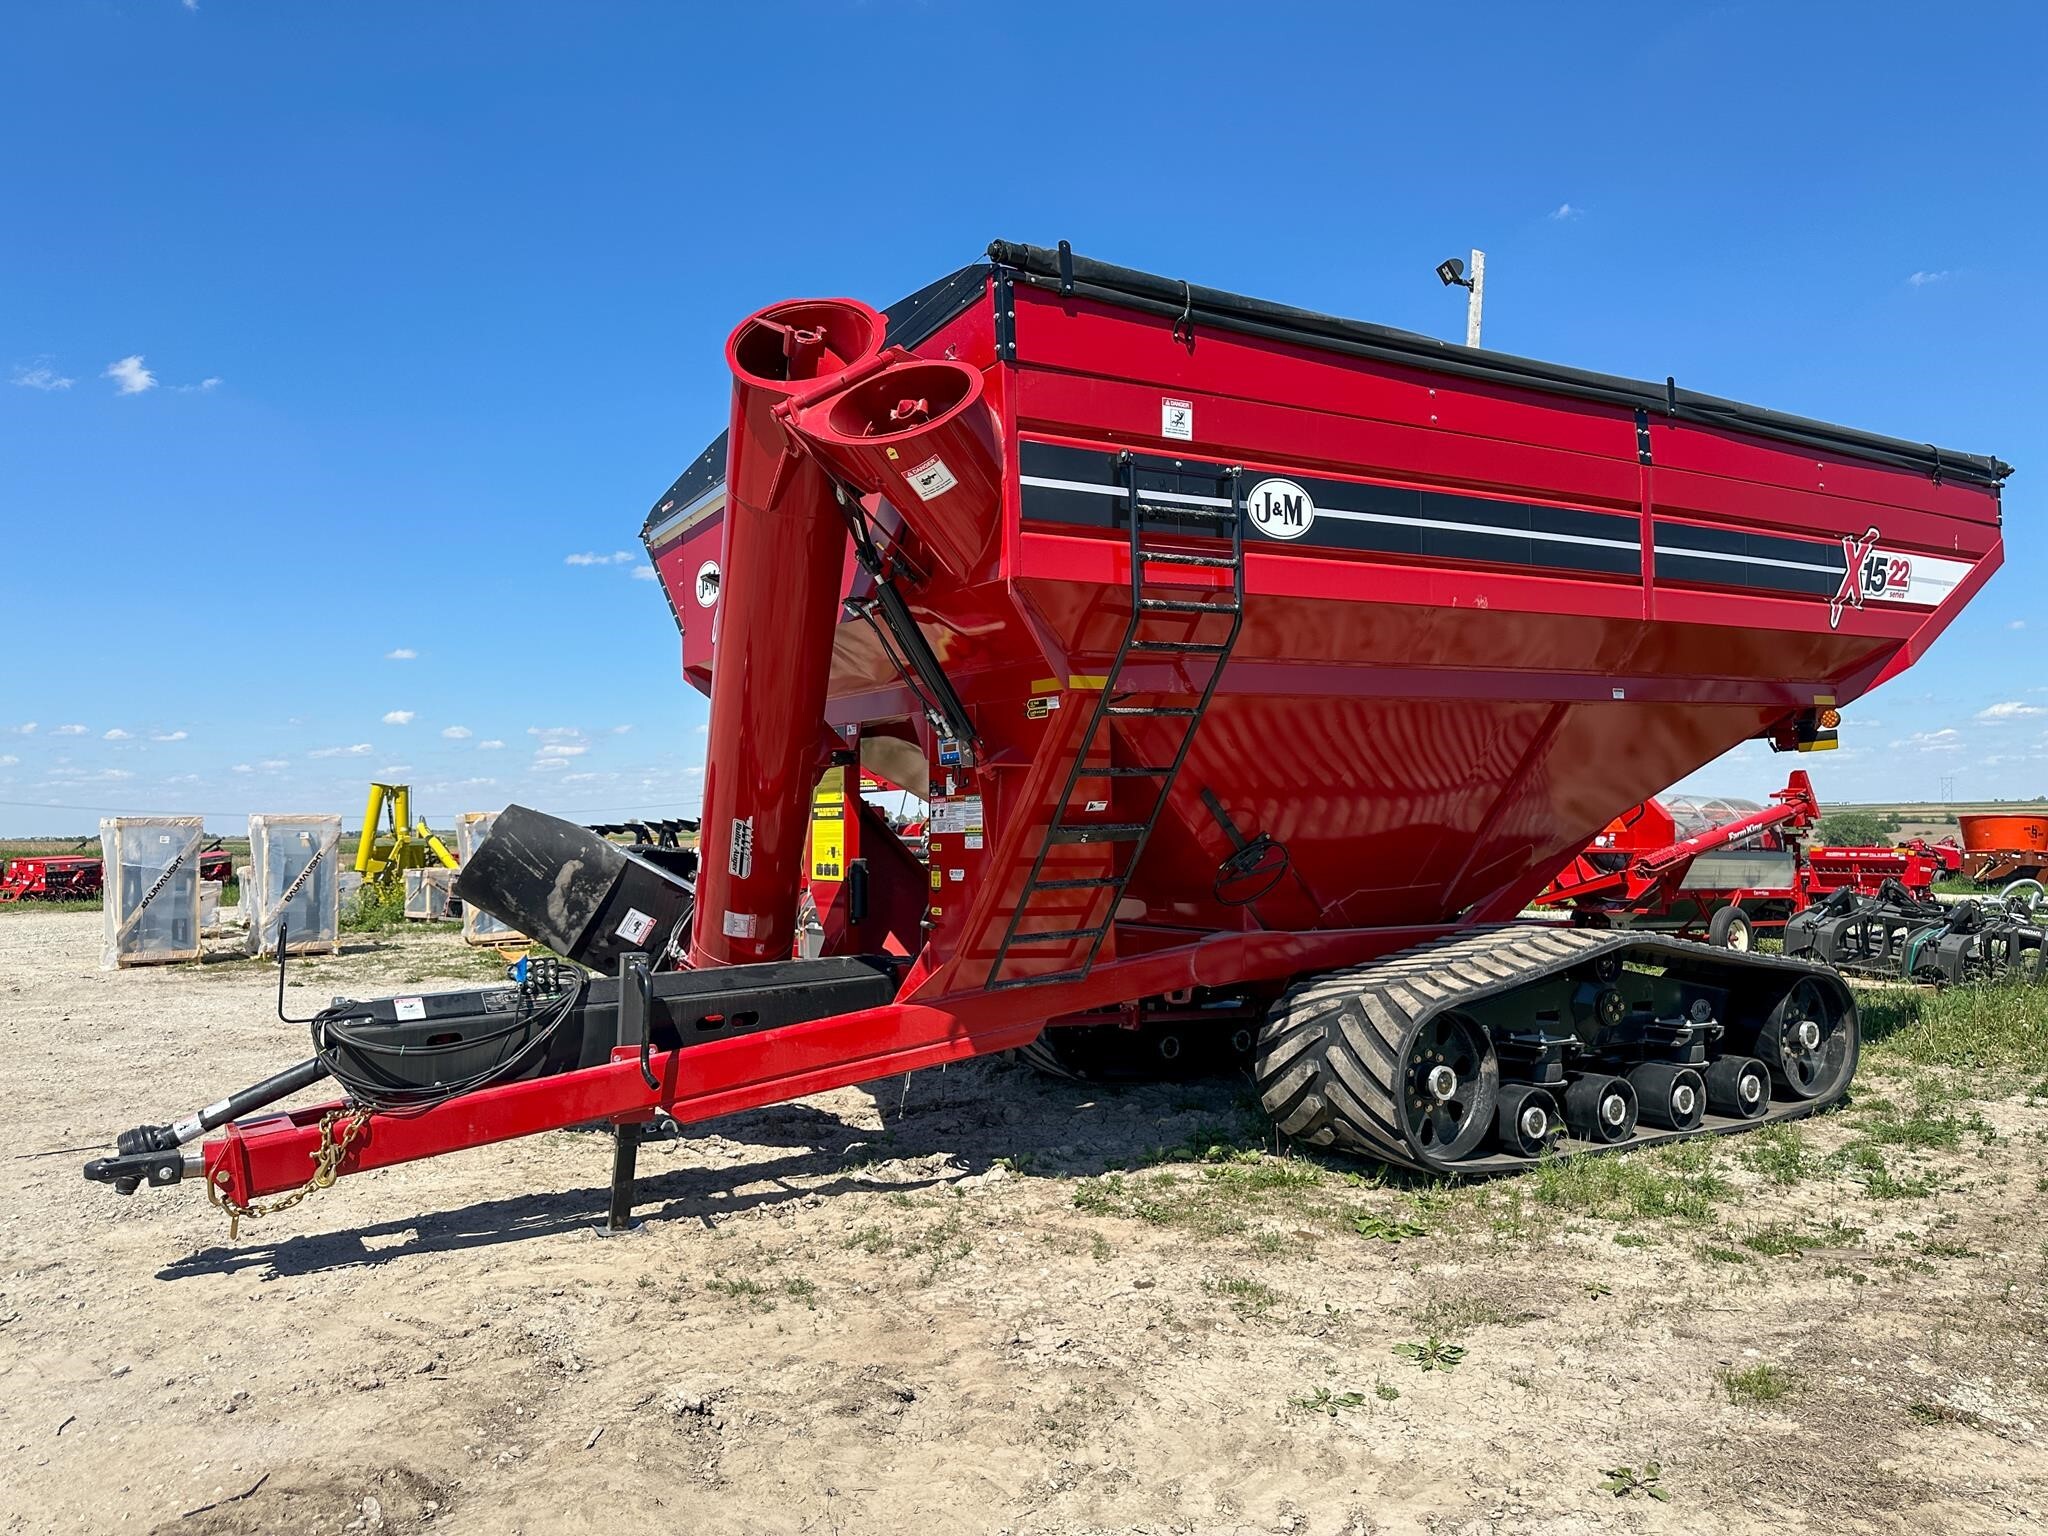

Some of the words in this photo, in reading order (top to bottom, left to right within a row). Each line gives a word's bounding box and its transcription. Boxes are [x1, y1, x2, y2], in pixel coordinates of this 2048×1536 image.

[1254, 491, 1304, 527] J&M
[734, 822, 743, 847] Bullet
[285, 850, 324, 902] BAUMALIGHT
[731, 847, 740, 873] Auger
[141, 855, 184, 908] BAUMALIGHT
